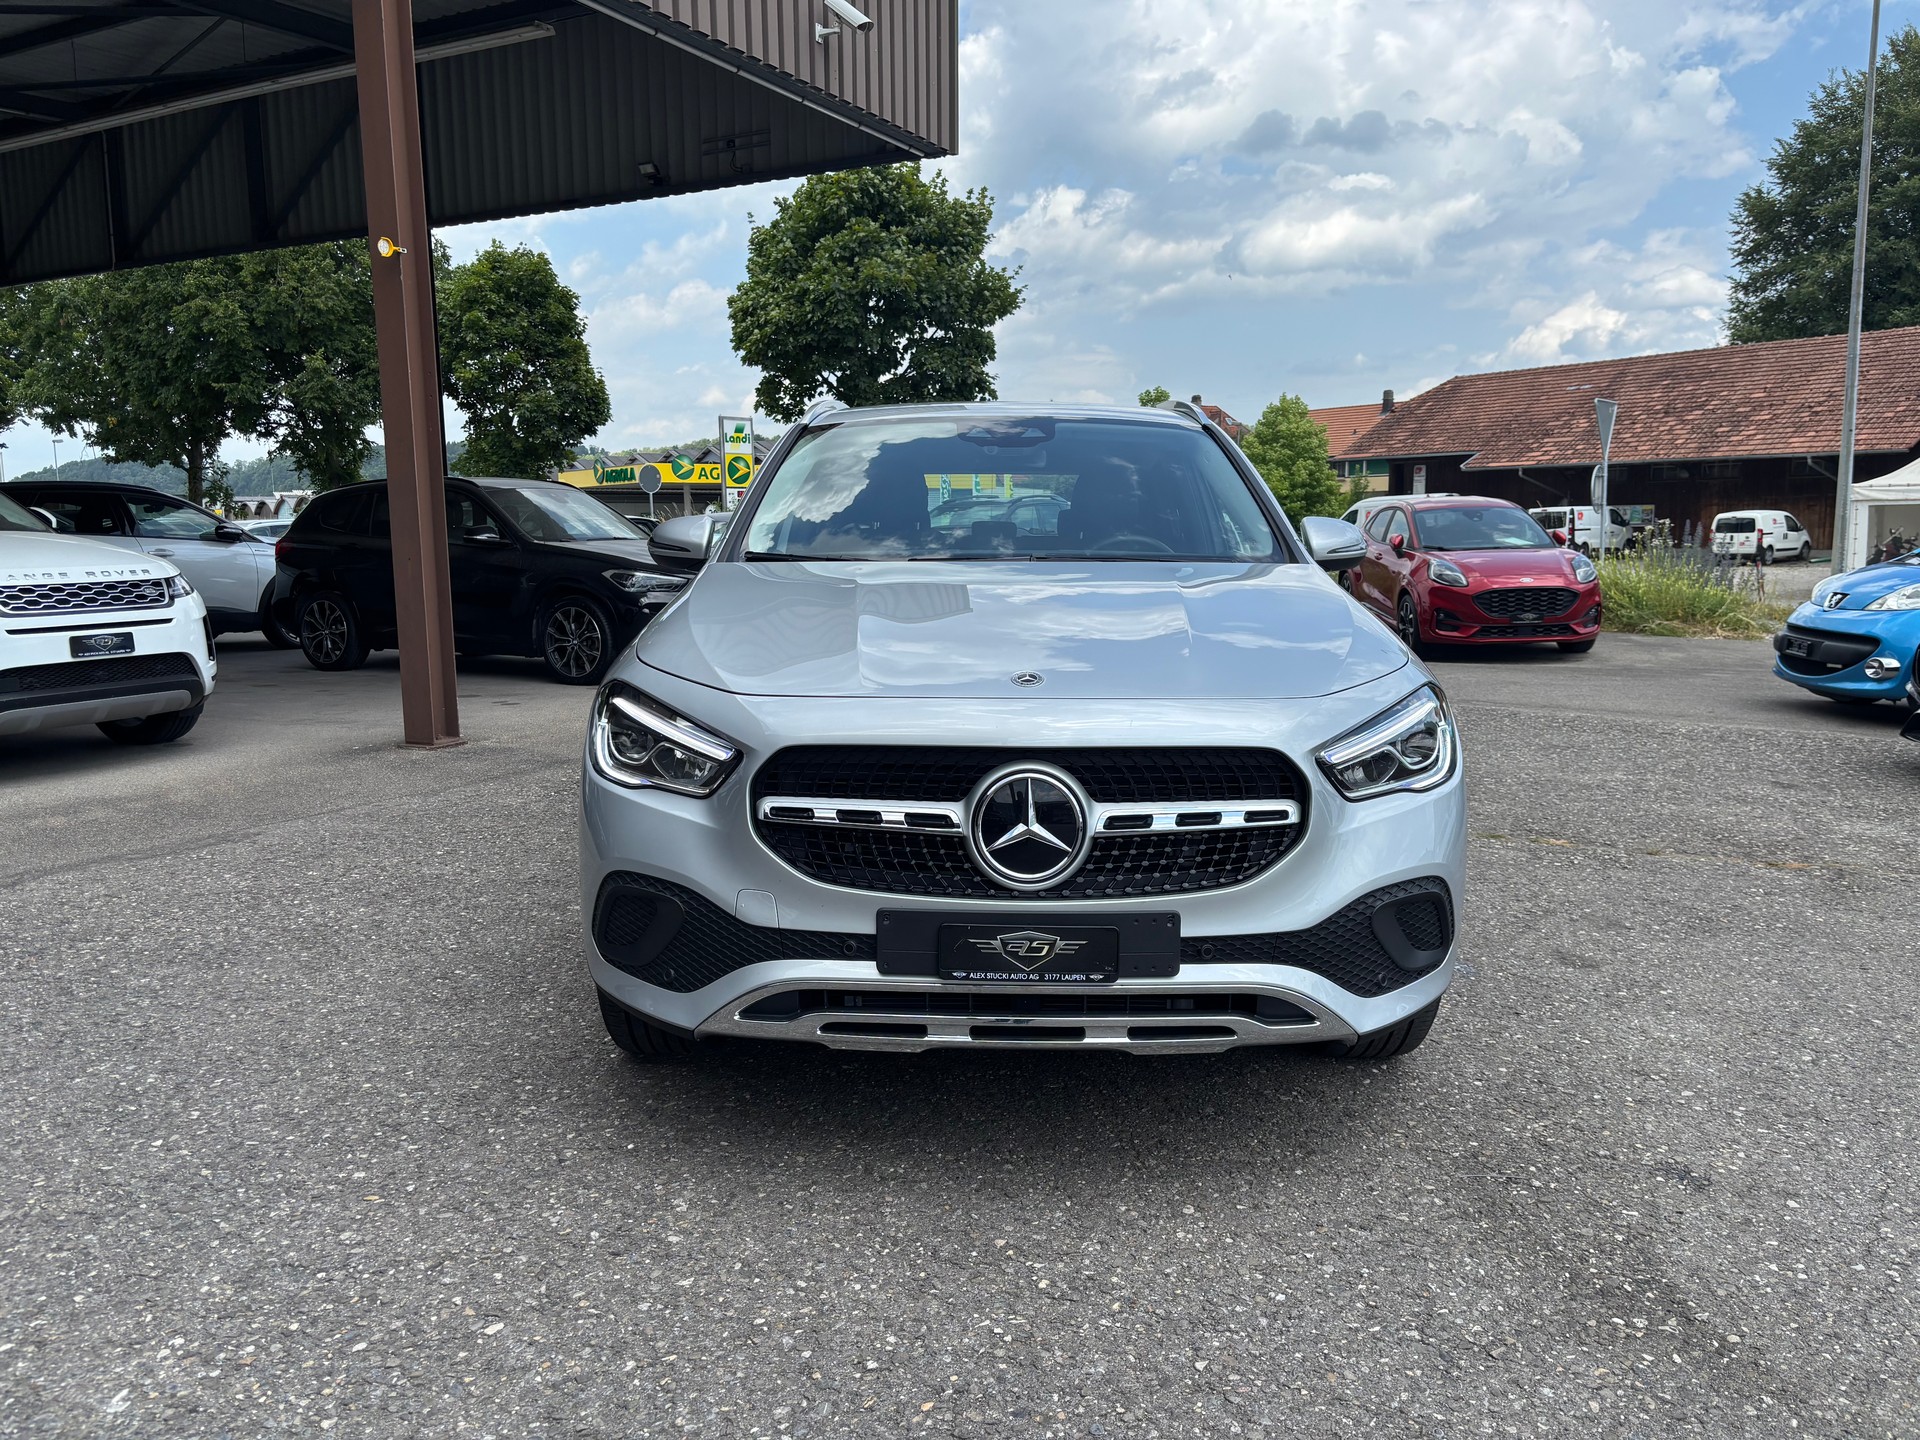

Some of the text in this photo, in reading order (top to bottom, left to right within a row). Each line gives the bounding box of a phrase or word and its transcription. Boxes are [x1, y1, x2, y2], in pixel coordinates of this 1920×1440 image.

[725, 433, 751, 444] Landi
[698, 467, 720, 480] AG
[6, 569, 151, 581] ANGE ROVER
[1044, 973, 1060, 981] 3177
